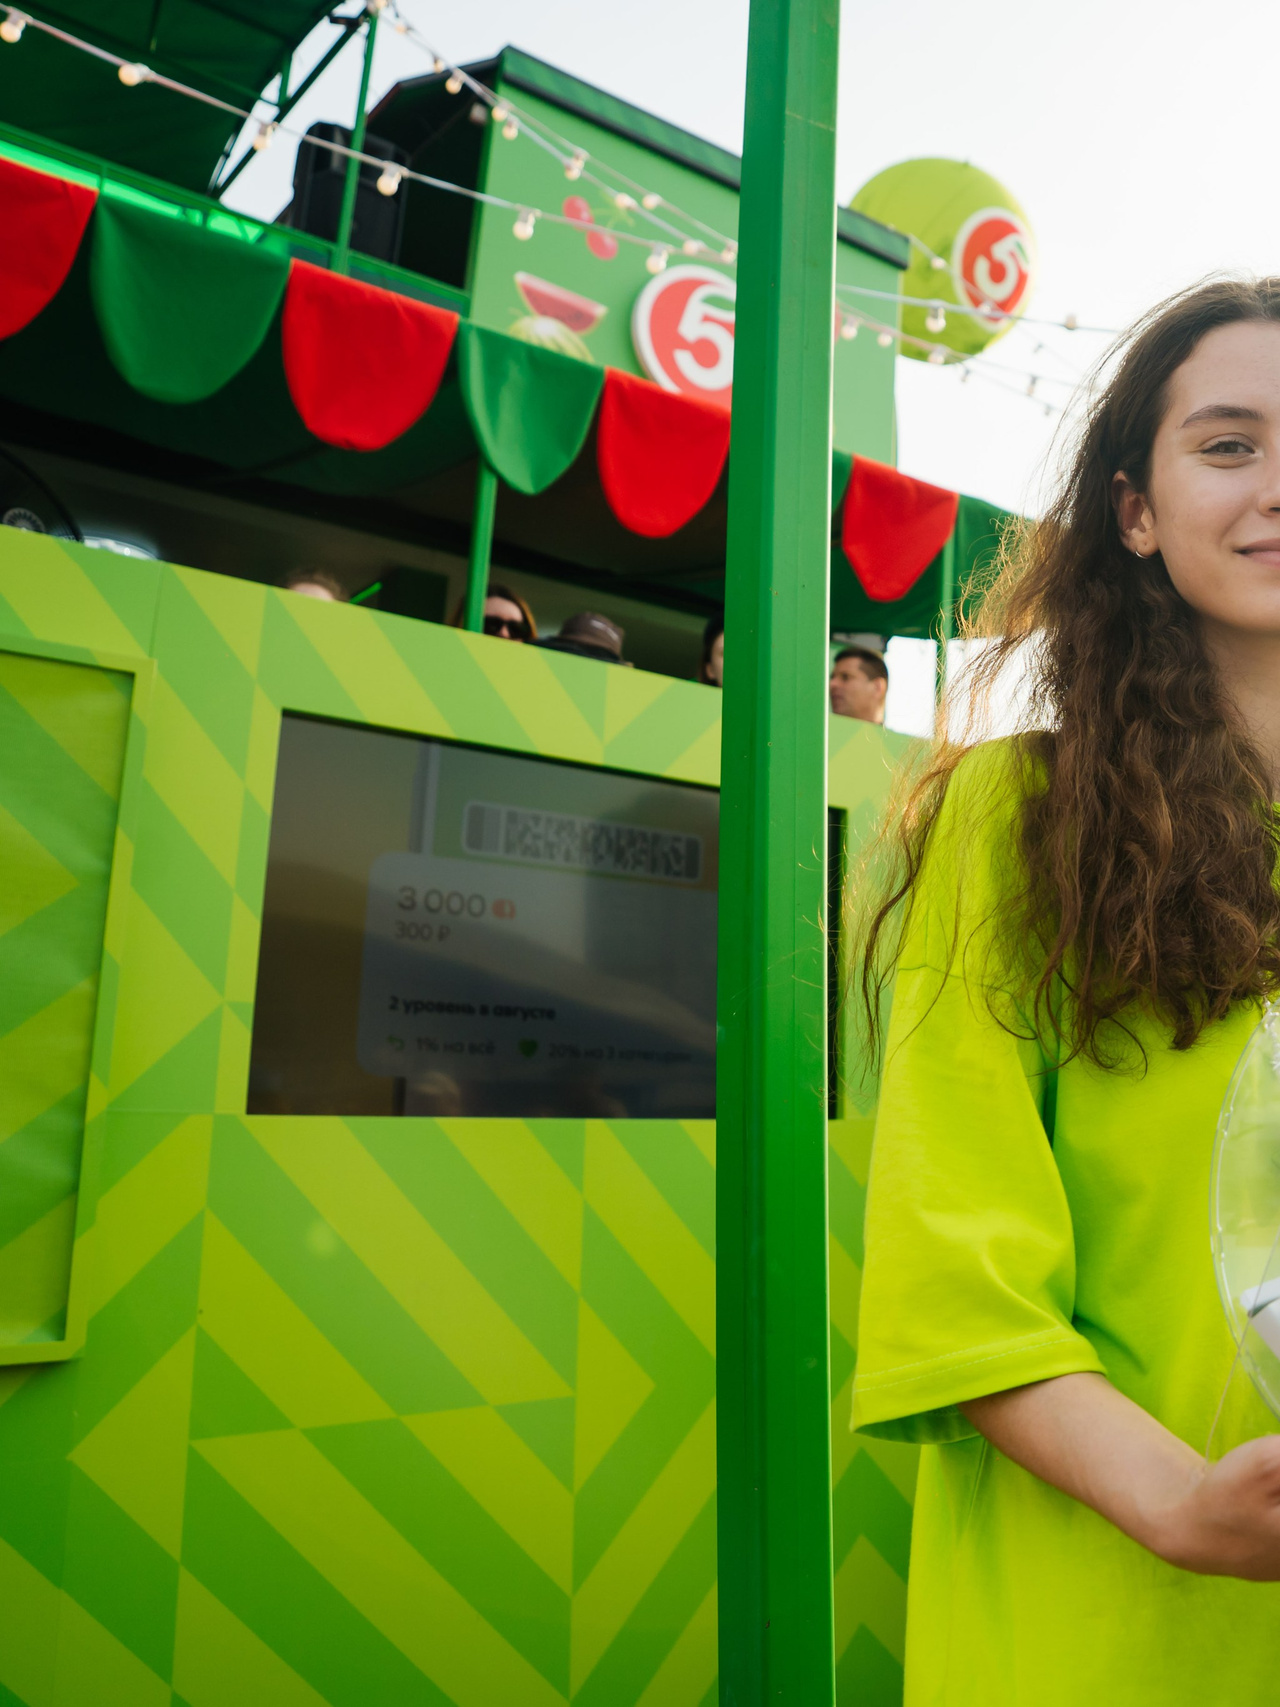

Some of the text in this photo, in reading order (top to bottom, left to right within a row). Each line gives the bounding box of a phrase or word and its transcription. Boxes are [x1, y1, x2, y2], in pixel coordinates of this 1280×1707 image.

[395, 919, 434, 942] 300
[388, 994, 557, 1022] 2 уровень в августе
[416, 1036, 497, 1056] 1% на всё
